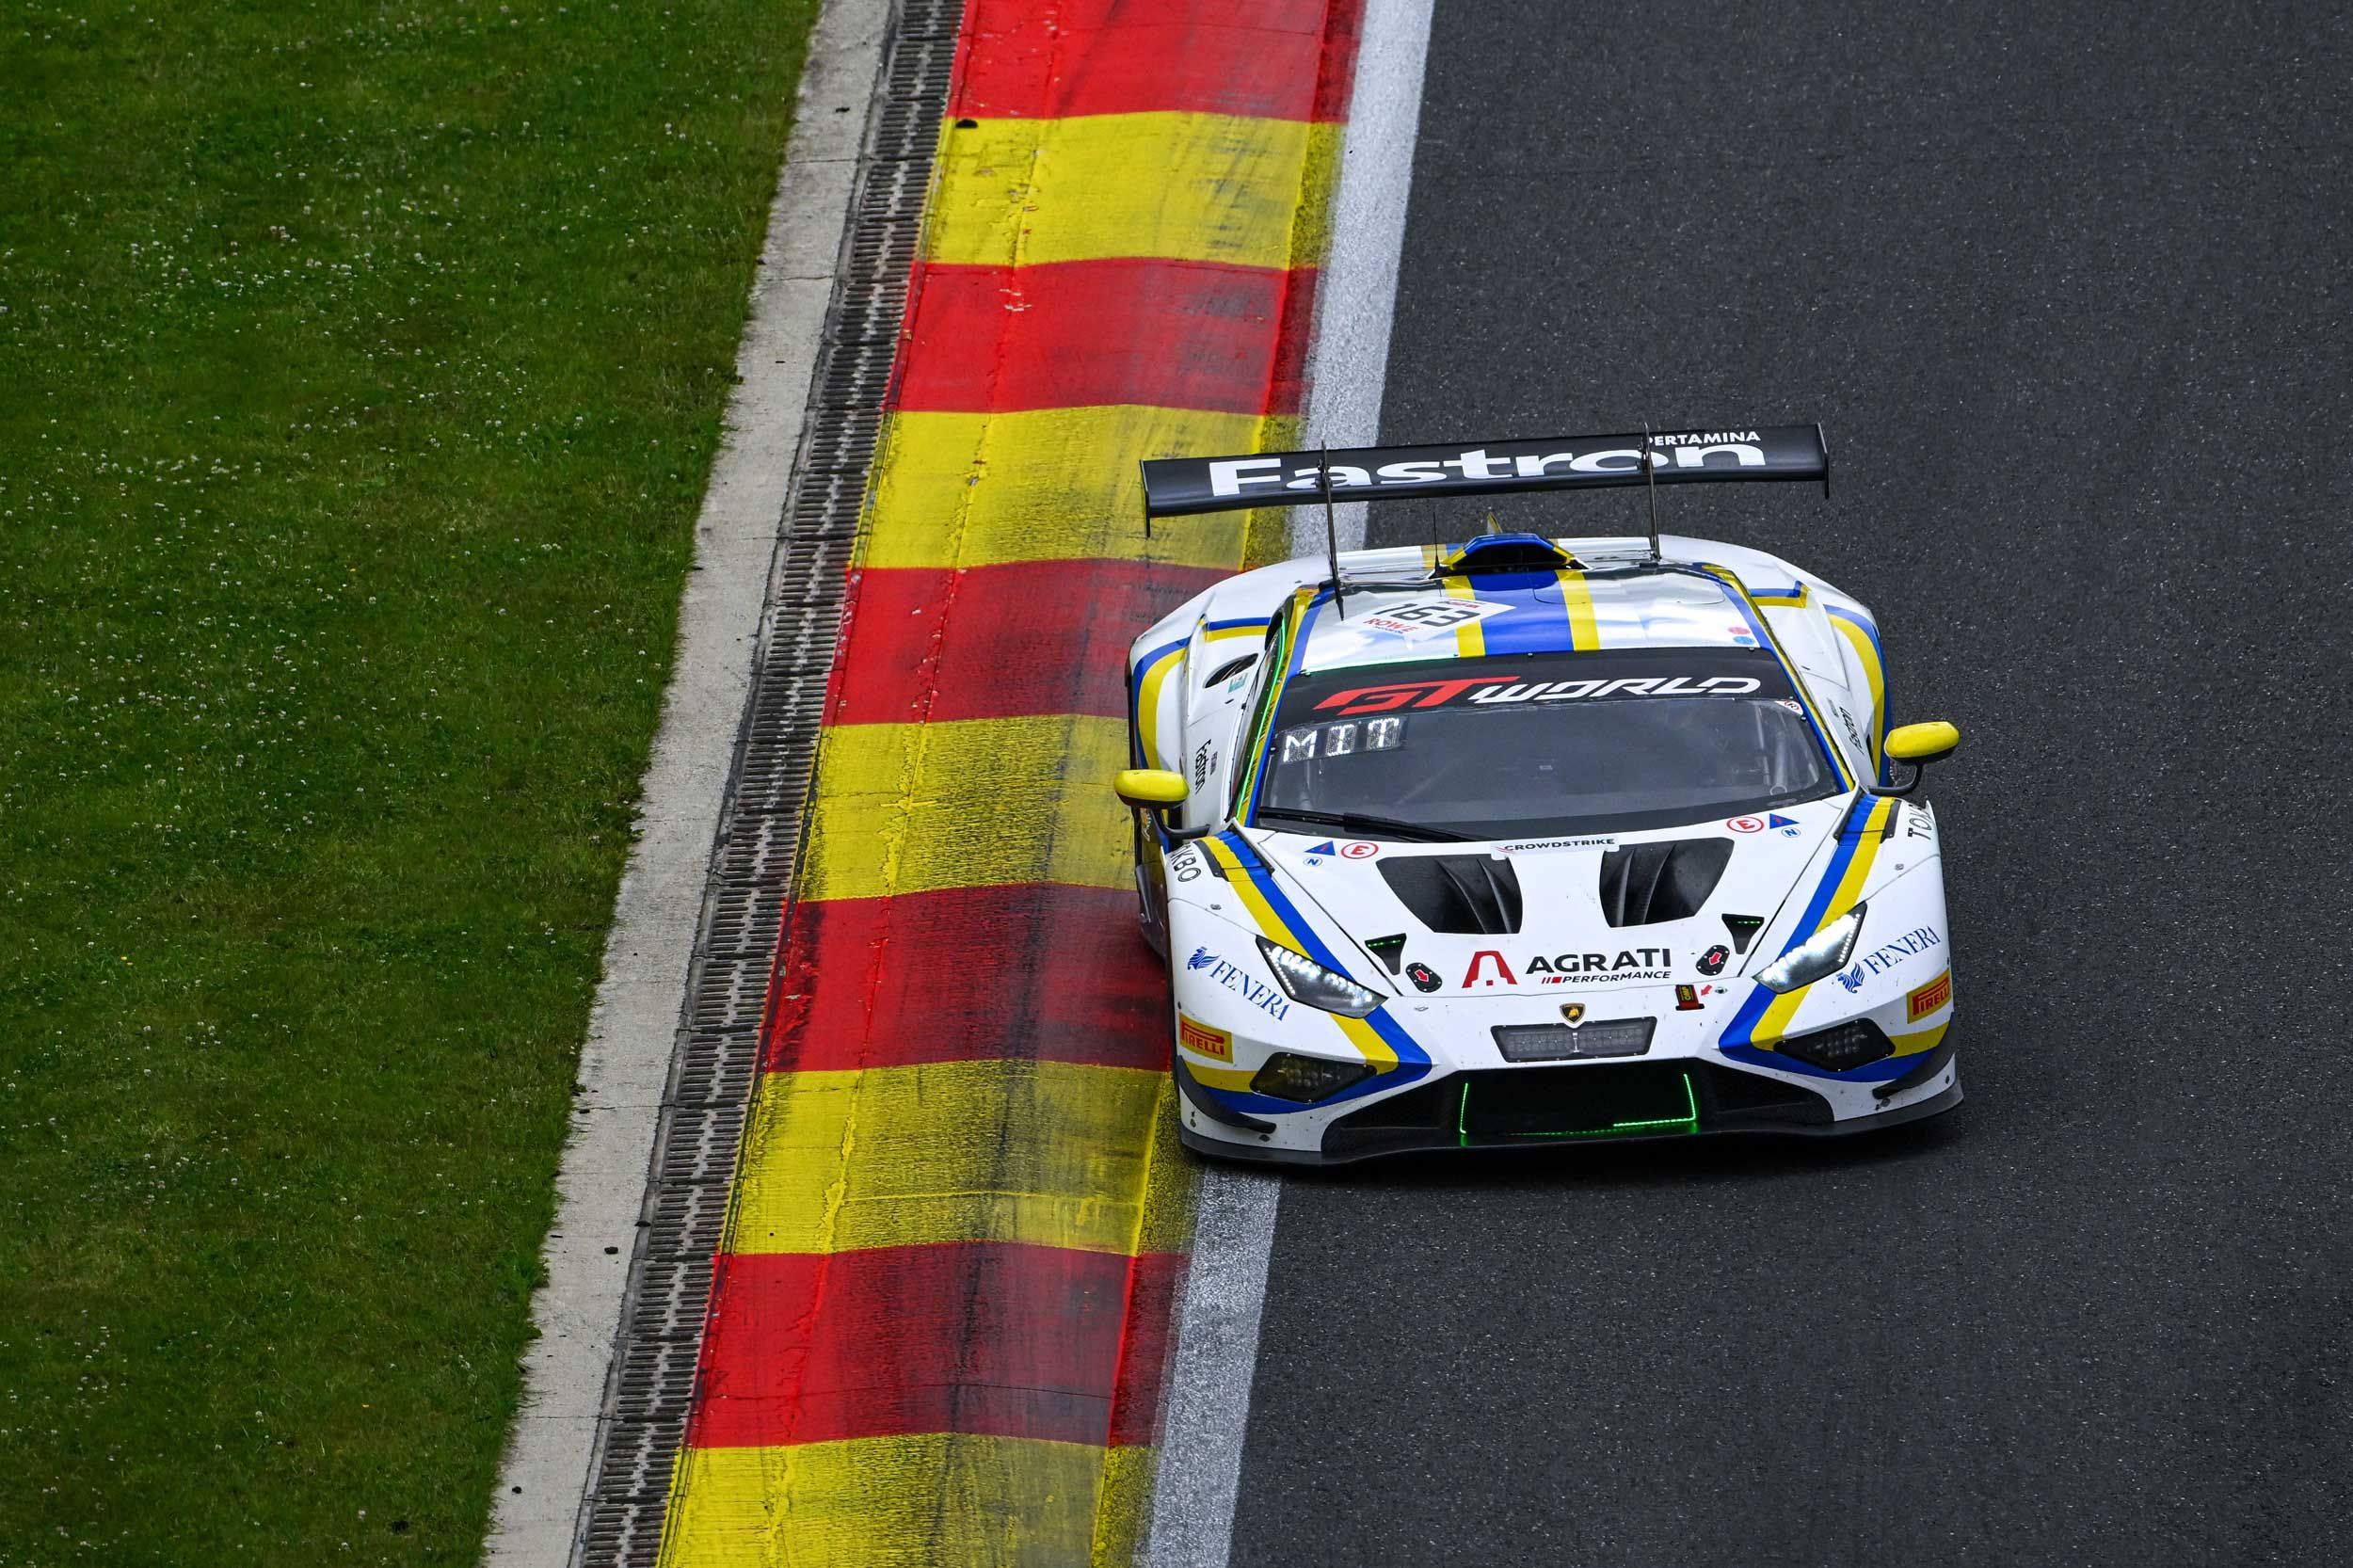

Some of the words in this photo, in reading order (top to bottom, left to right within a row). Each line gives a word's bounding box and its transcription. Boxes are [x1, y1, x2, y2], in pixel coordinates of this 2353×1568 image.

[1209, 442, 1766, 497] Fastron
[1364, 618, 1418, 632] ROWE
[1372, 603, 1481, 627] 163
[1504, 839, 1615, 851] CROWDSTRIKE
[1526, 948, 1672, 975] AGRATI
[1562, 971, 1672, 984] PERFORMANCE
[1913, 978, 1949, 1016] PIRELLI
[1181, 1020, 1225, 1056] PIRELLI
